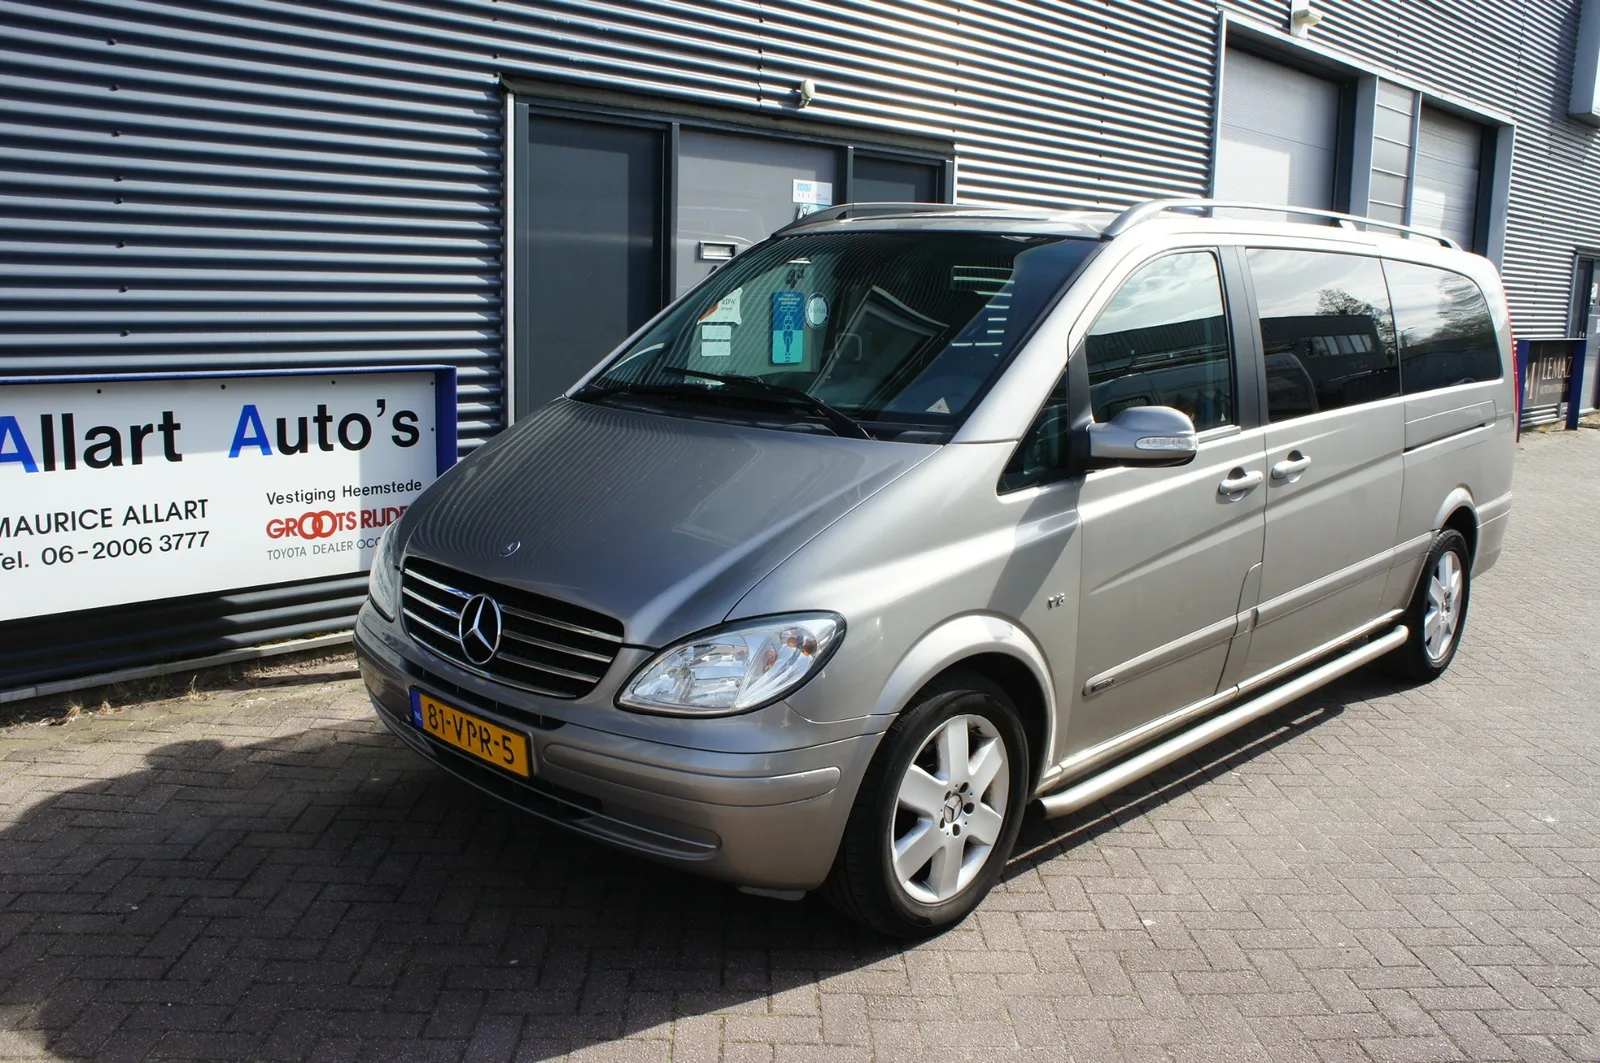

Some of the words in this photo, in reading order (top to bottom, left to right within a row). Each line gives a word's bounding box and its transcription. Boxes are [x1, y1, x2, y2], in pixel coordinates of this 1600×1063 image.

[0, 411, 183, 473] Allart
[228, 399, 420, 458] Auto's
[266, 488, 336, 505] Vestiging
[342, 479, 422, 497] Heemstede
[122, 499, 209, 526] ALLART
[266, 510, 357, 539] GROOTS
[0, 551, 30, 570] el.
[159, 531, 210, 552] 3777
[267, 547, 307, 560] TOYOTA
[312, 540, 354, 555] DEALER
[427, 703, 515, 765] 81-VPR-5
